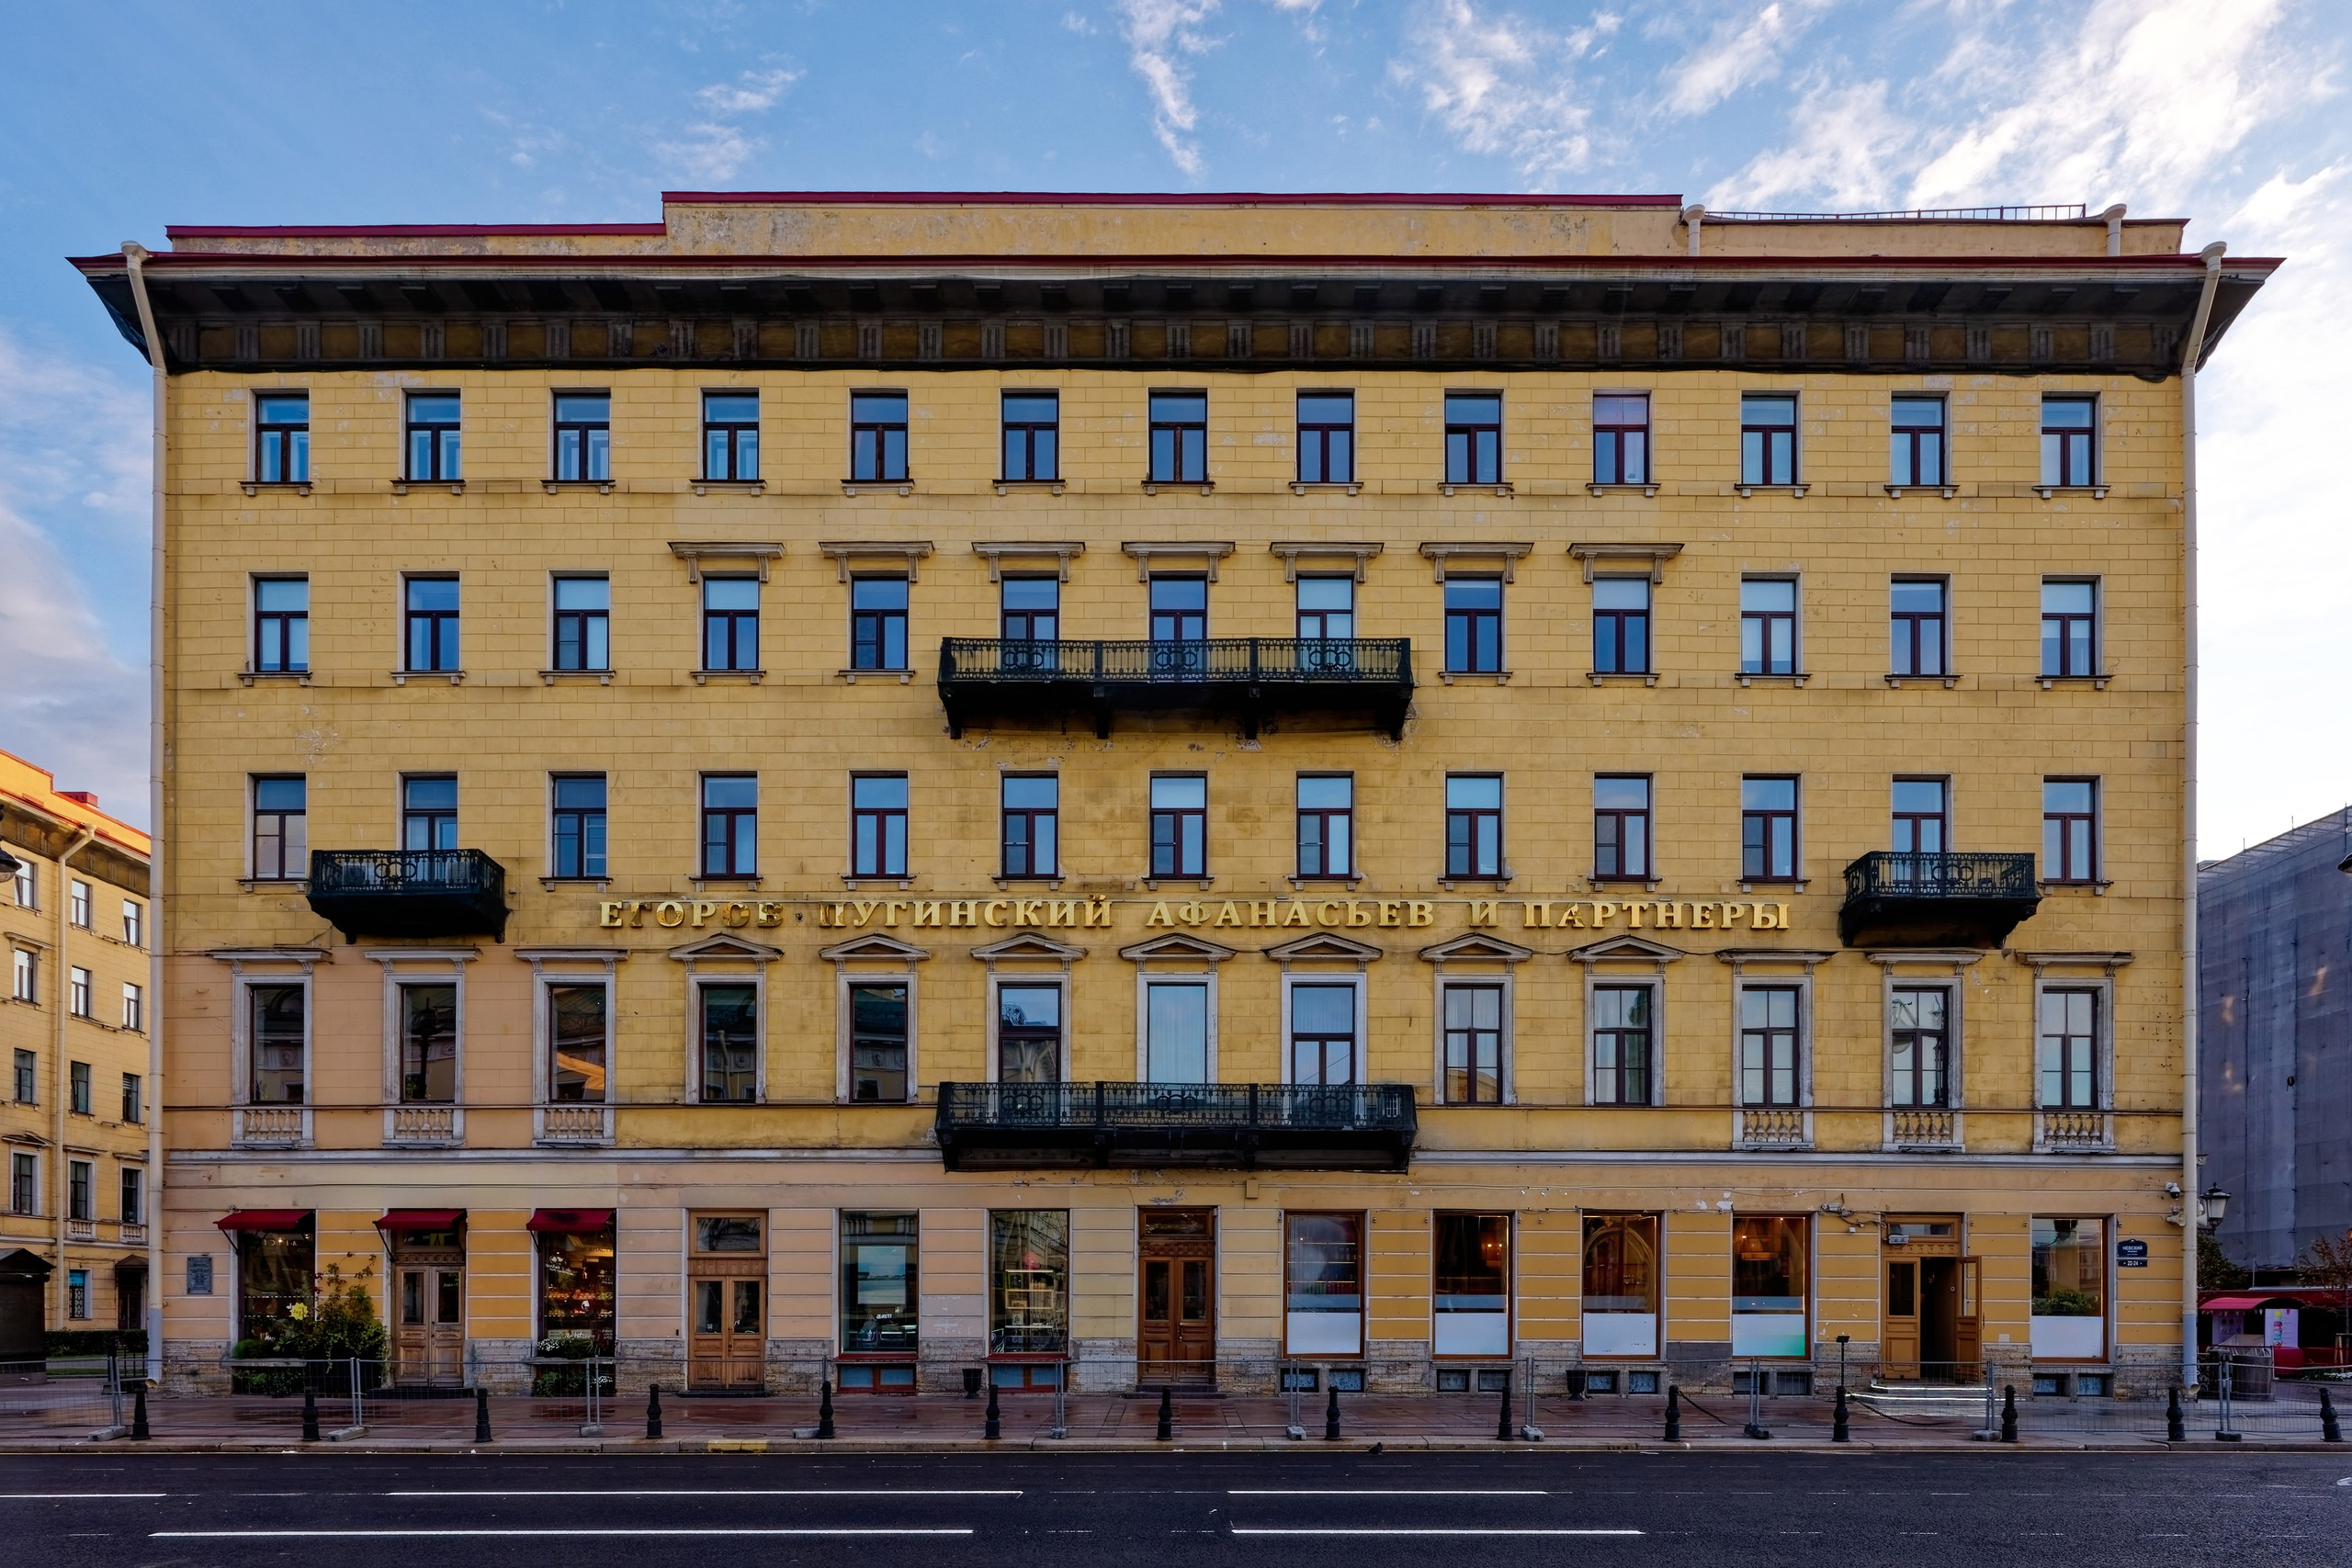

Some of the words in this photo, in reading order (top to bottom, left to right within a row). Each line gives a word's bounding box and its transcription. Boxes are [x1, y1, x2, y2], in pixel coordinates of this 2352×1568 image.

[819, 895, 1113, 928] ПУГИНСКИЙ
[1146, 901, 1434, 928] АФАНАСЬЕВ
[1470, 901, 1499, 928] И
[1523, 901, 1790, 930] ПАРТНЕРЫ
